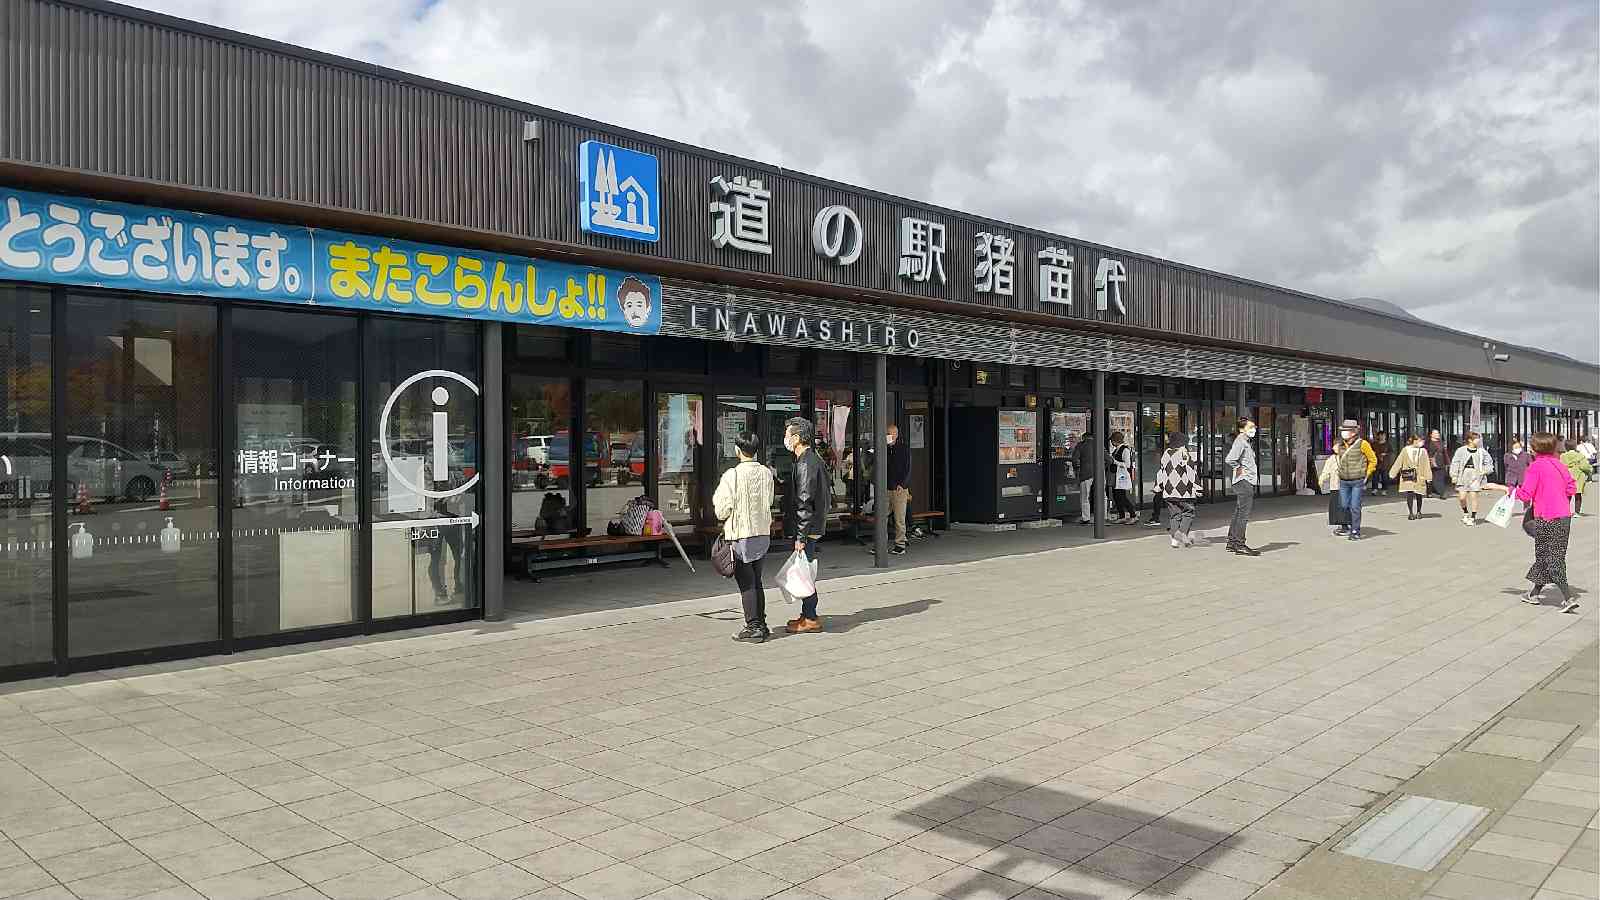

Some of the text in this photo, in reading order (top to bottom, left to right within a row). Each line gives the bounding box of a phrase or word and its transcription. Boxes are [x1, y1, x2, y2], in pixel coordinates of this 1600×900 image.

[0, 196, 301, 294] とうございます。
[709, 174, 1128, 316] 道の駅猪苗代
[328, 240, 607, 322] またこらんしょ!!
[691, 304, 920, 349] INAWASHIRO
[238, 449, 356, 475] 情報コーナー
[274, 476, 356, 491] Information
[411, 528, 439, 540] 出入口
